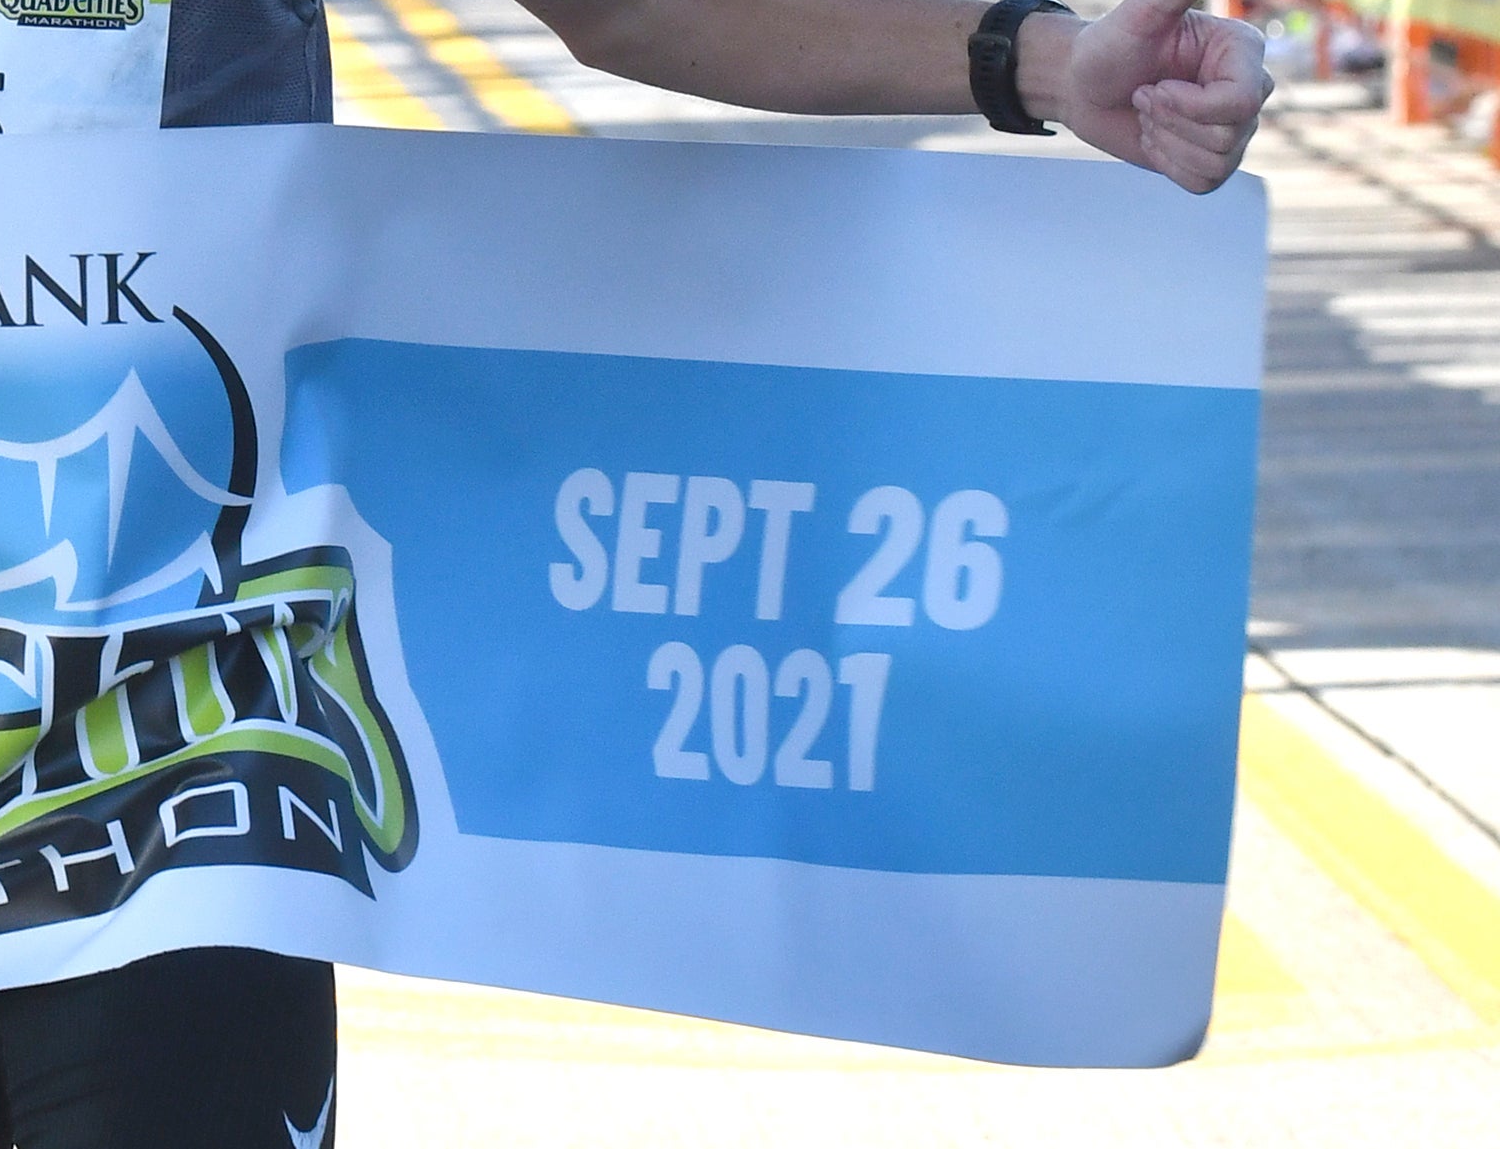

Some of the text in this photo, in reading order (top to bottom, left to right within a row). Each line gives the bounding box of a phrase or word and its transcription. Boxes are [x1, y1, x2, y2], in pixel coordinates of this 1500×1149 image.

[24, 17, 121, 28] MARATHON
[548, 467, 1010, 631] SEPT 26
[646, 640, 893, 792] 2021
